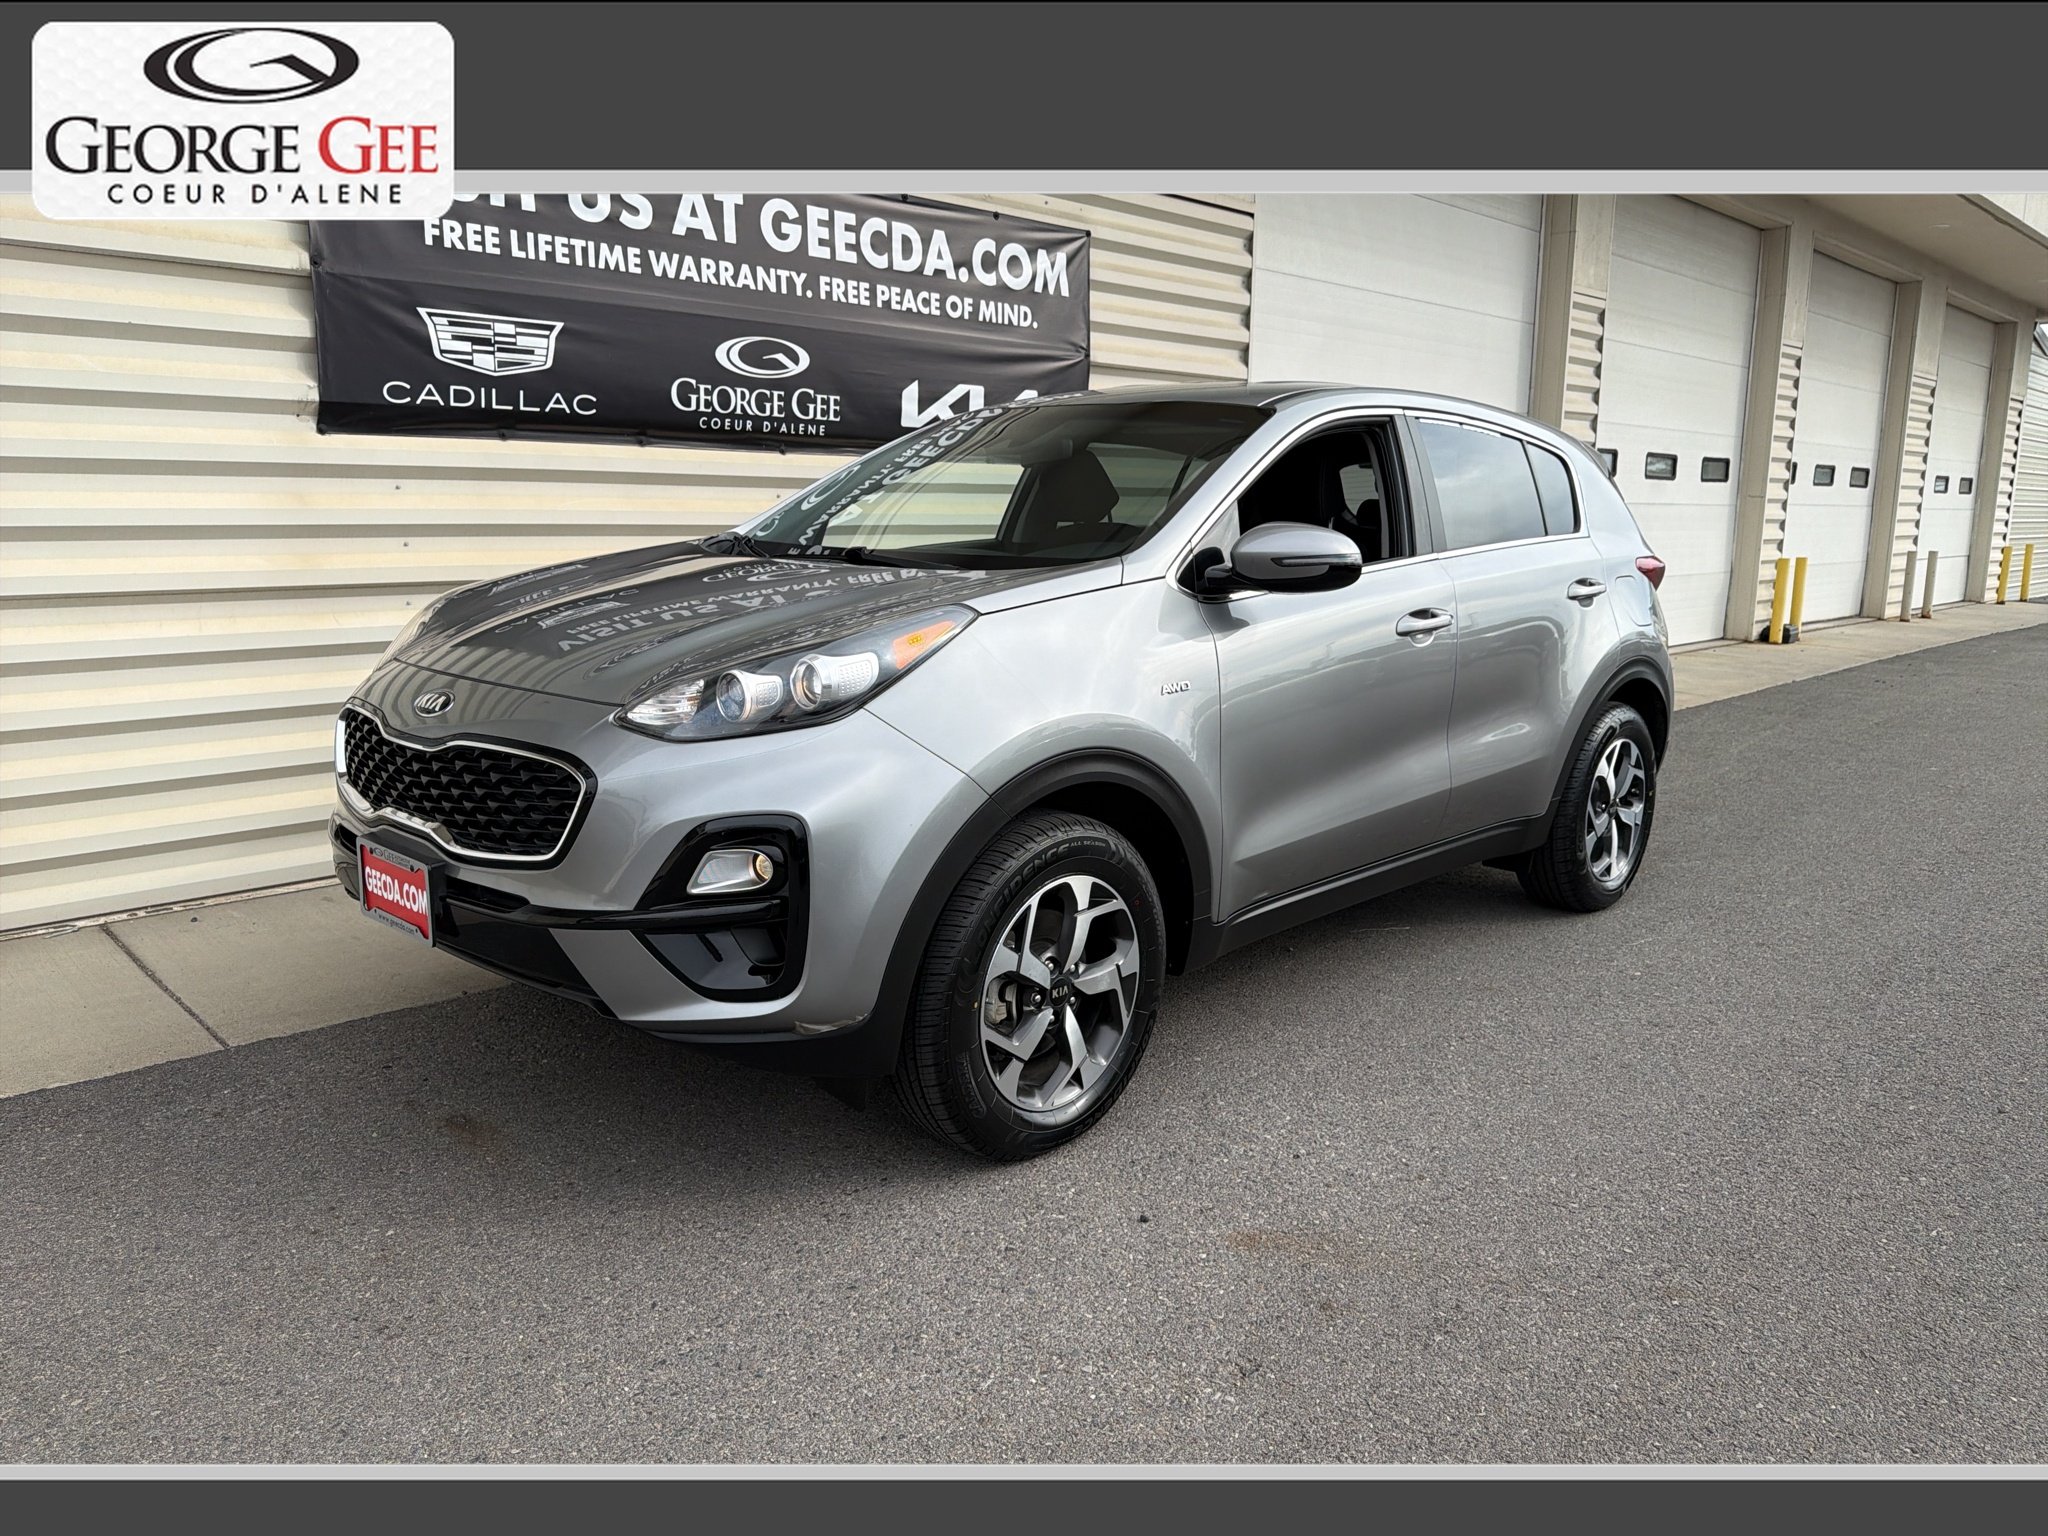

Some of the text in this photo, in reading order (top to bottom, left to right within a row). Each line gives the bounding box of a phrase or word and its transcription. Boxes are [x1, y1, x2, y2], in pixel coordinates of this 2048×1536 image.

[672, 193, 743, 244] AT
[760, 198, 1070, 297] GEECDA.COM
[424, 218, 1038, 329] FREE LIFETIME WARRANTY. FREE PEACE OF MIND.
[382, 381, 597, 415] CADILLAC
[671, 377, 841, 422] GEORGE GEE
[699, 416, 826, 436] COEUR D'ALENE
[417, 693, 447, 711] KIA
[1161, 680, 1191, 696] AWD
[365, 866, 429, 916] GEECDA.COM
[1052, 985, 1068, 998] KIA
